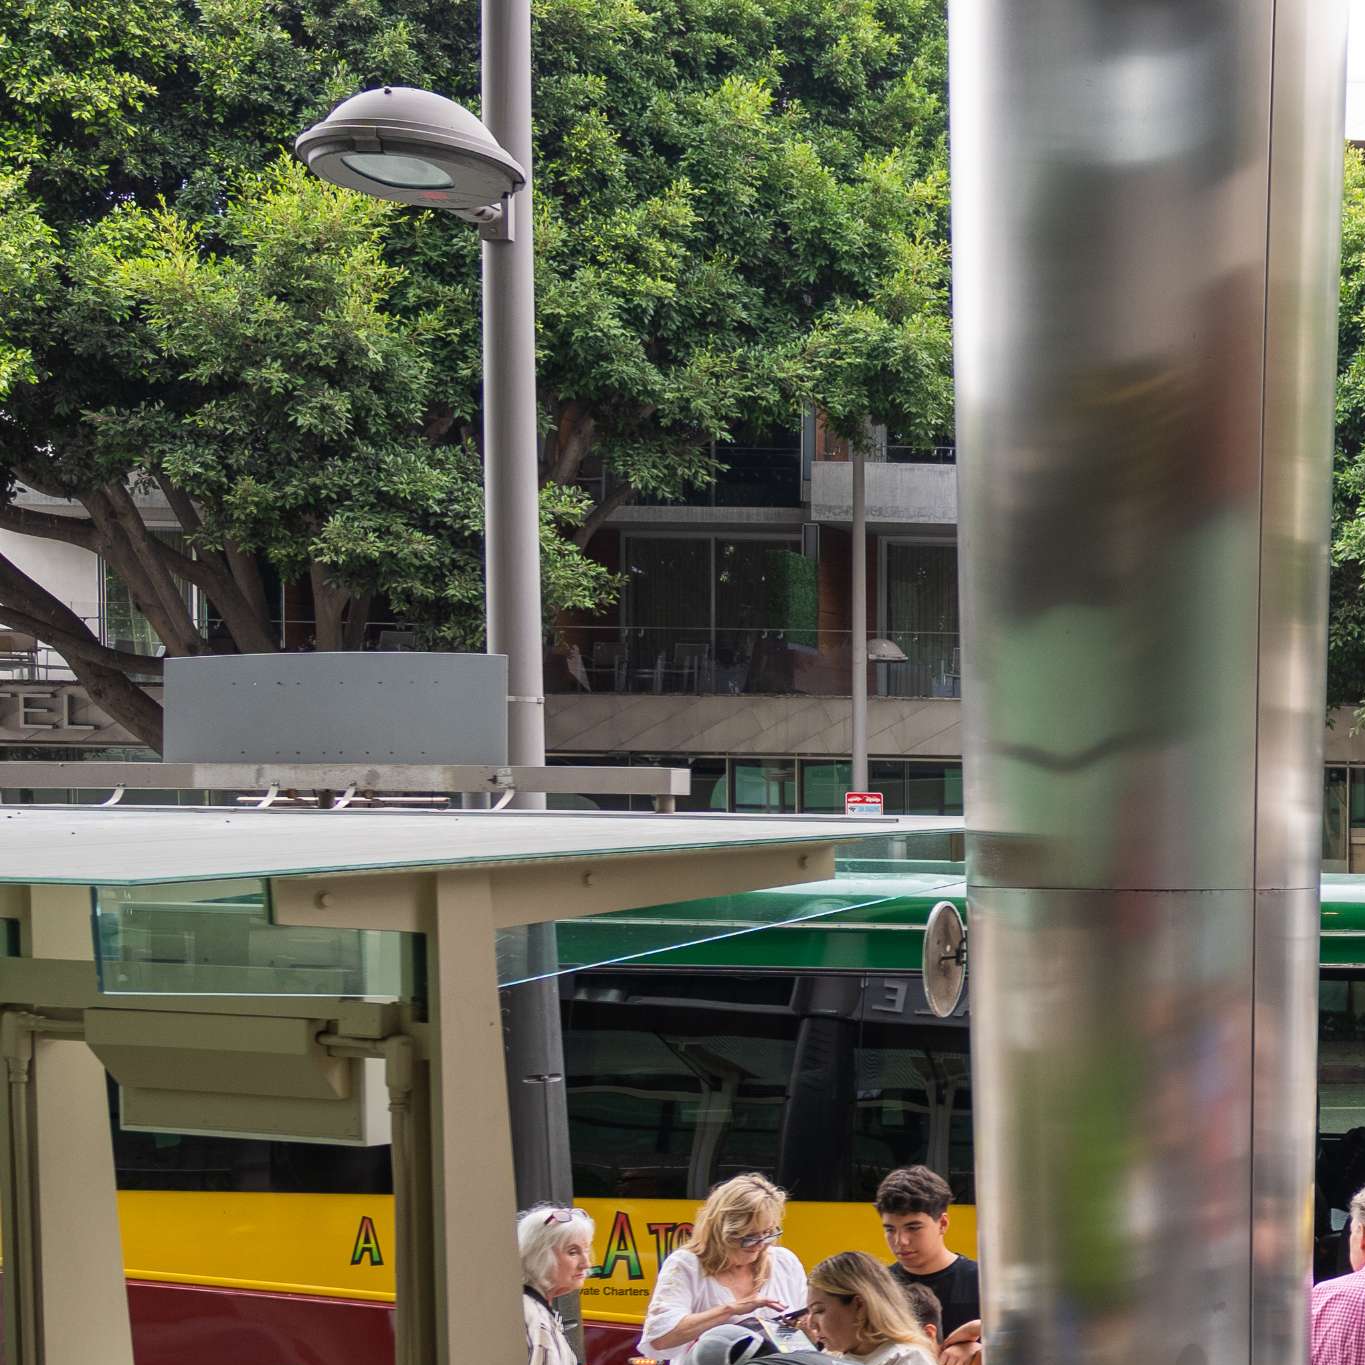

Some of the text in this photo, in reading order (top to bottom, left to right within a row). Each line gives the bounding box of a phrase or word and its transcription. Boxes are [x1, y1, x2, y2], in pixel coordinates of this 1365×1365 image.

[0, 692, 95, 729] EL
[579, 1286, 650, 1297] vate Charters
